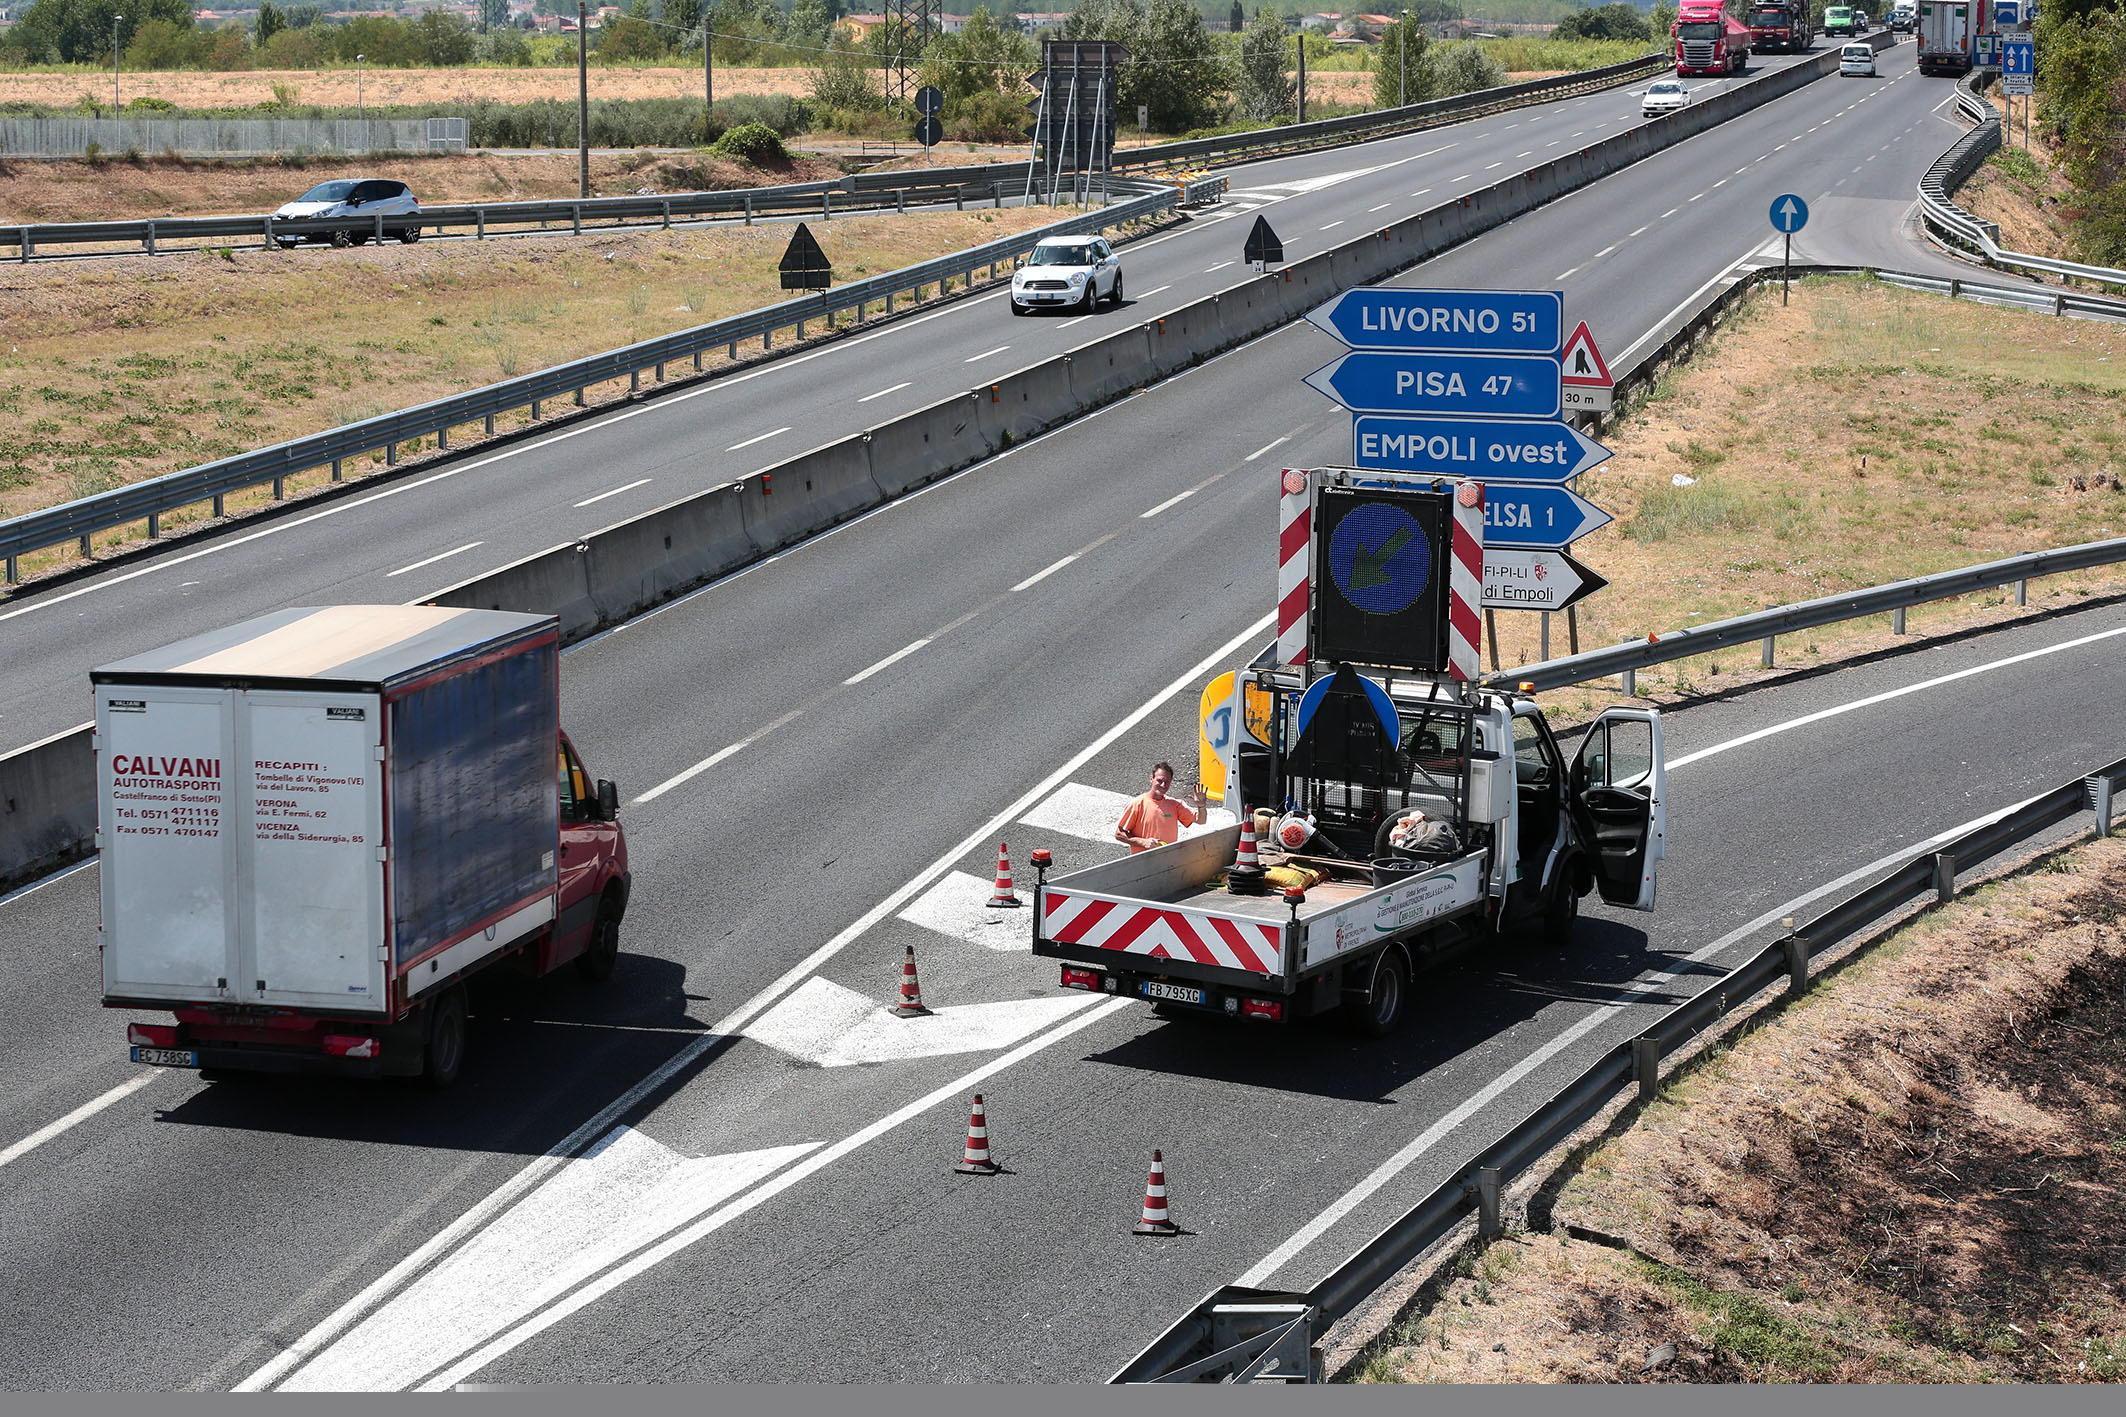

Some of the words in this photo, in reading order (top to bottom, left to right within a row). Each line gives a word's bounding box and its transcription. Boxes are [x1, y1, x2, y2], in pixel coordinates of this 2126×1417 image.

[1362, 306, 1500, 334] LIVORNO
[1512, 311, 1536, 333] 51
[1396, 370, 1466, 397] PISA
[1482, 375, 1512, 396] 47
[1565, 392, 1580, 404] 30
[1584, 396, 1594, 404] m
[1361, 432, 1476, 462] EMPOLI
[1488, 439, 1568, 465] ovest
[1546, 506, 1554, 527] 1
[1484, 566, 1528, 580] FI-PI-LI
[1485, 585, 1498, 600] di
[1503, 586, 1553, 603] Empoli
[112, 754, 221, 778] CALVANI
[255, 760, 319, 770] RECAPITI
[114, 778, 221, 791] AUTOTRASPORTI
[256, 773, 294, 782] Tombelle
[296, 774, 304, 783] di
[307, 776, 346, 786] Vigonovo
[348, 777, 364, 786] (VE)
[113, 791, 168, 801] Castelfranco
[170, 794, 178, 802] di
[256, 800, 298, 808] VERONA
[116, 808, 137, 818] Tel.
[141, 810, 168, 820] 0571
[171, 807, 219, 817] 471116
[256, 808, 269, 816] via
[172, 817, 219, 826] 471117
[256, 823, 300, 832] VICENZA
[117, 826, 137, 834] Fax
[141, 827, 169, 835] 0571
[174, 828, 219, 837] 470147
[256, 832, 270, 840] via
[272, 832, 295, 840] della
[1150, 983, 1162, 996] FB
[1165, 986, 1198, 1002] 795XG
